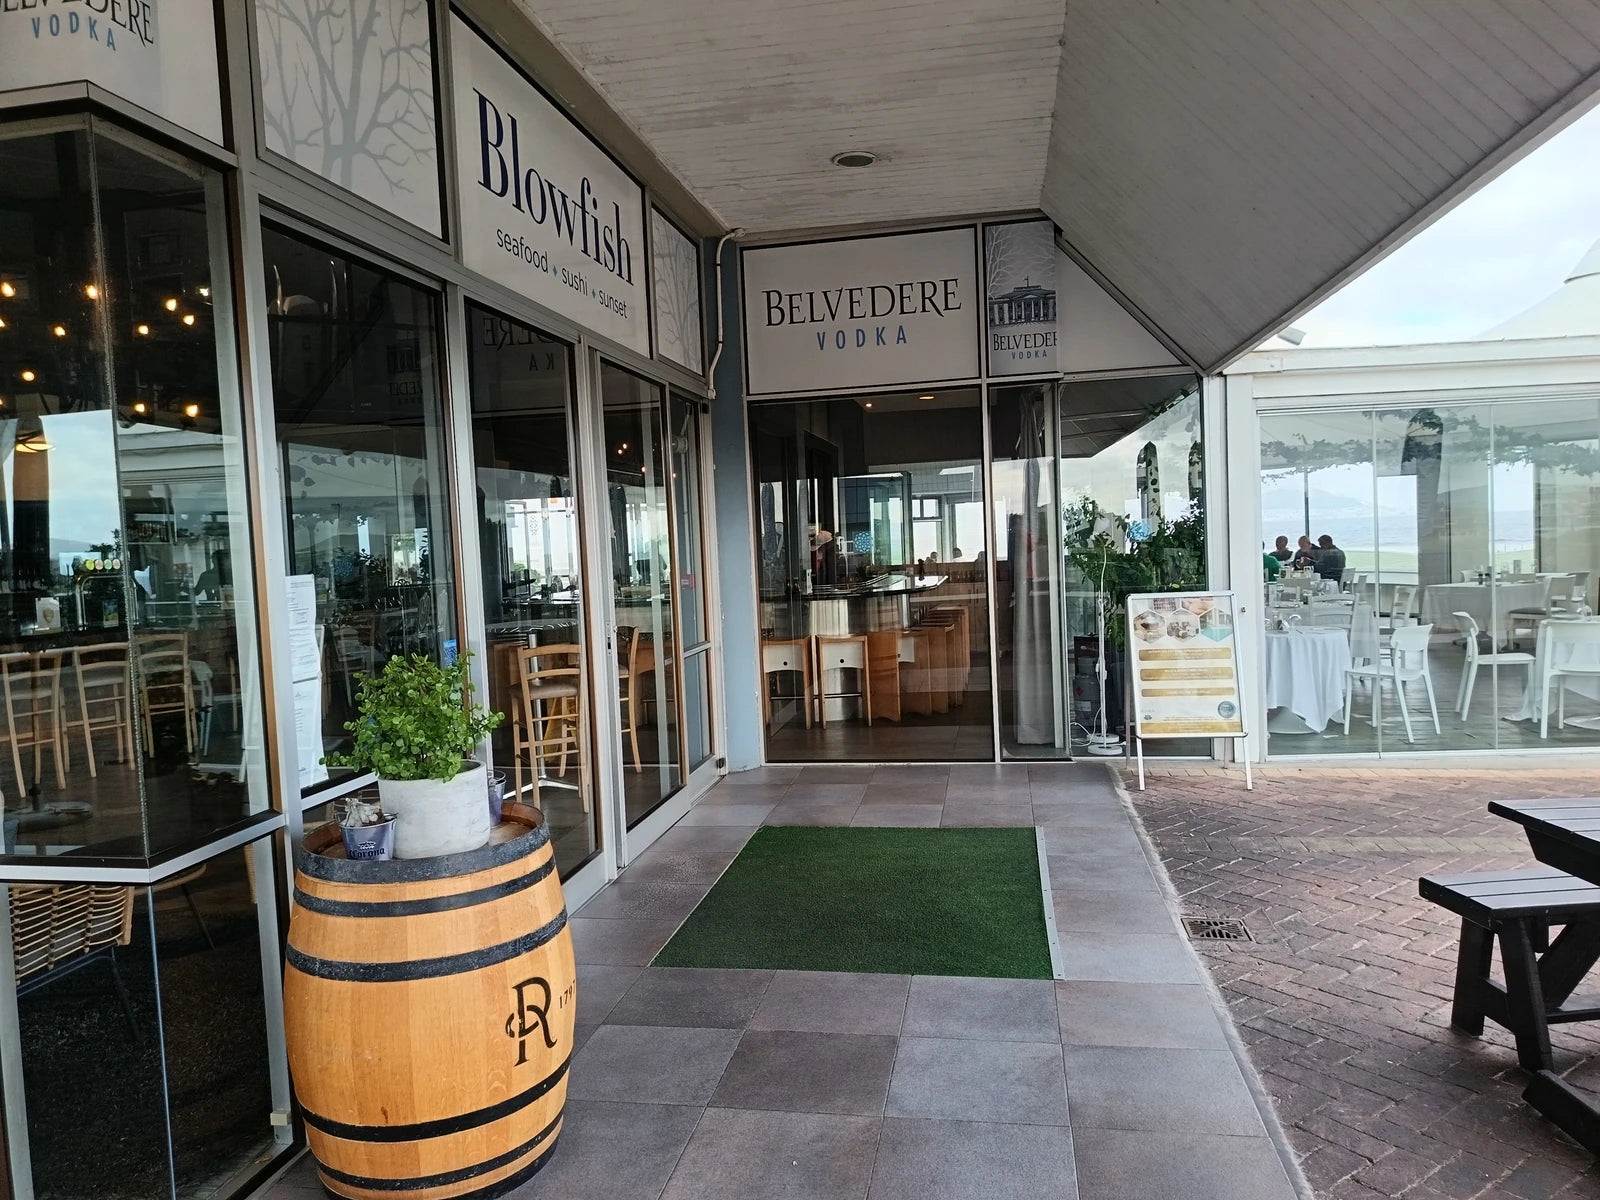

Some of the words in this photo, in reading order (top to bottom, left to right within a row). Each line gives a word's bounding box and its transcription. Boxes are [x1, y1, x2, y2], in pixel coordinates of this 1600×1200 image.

[32, 11, 116, 51] VODKA
[472, 87, 634, 287] Blowfish
[496, 228, 549, 274] seafood
[561, 267, 588, 297] sushi
[598, 289, 628, 319] sunset
[762, 277, 962, 327] BELVEDERE
[816, 324, 908, 351] VODKA
[1012, 349, 1048, 360] VODKA
[349, 847, 385, 860] Corona
